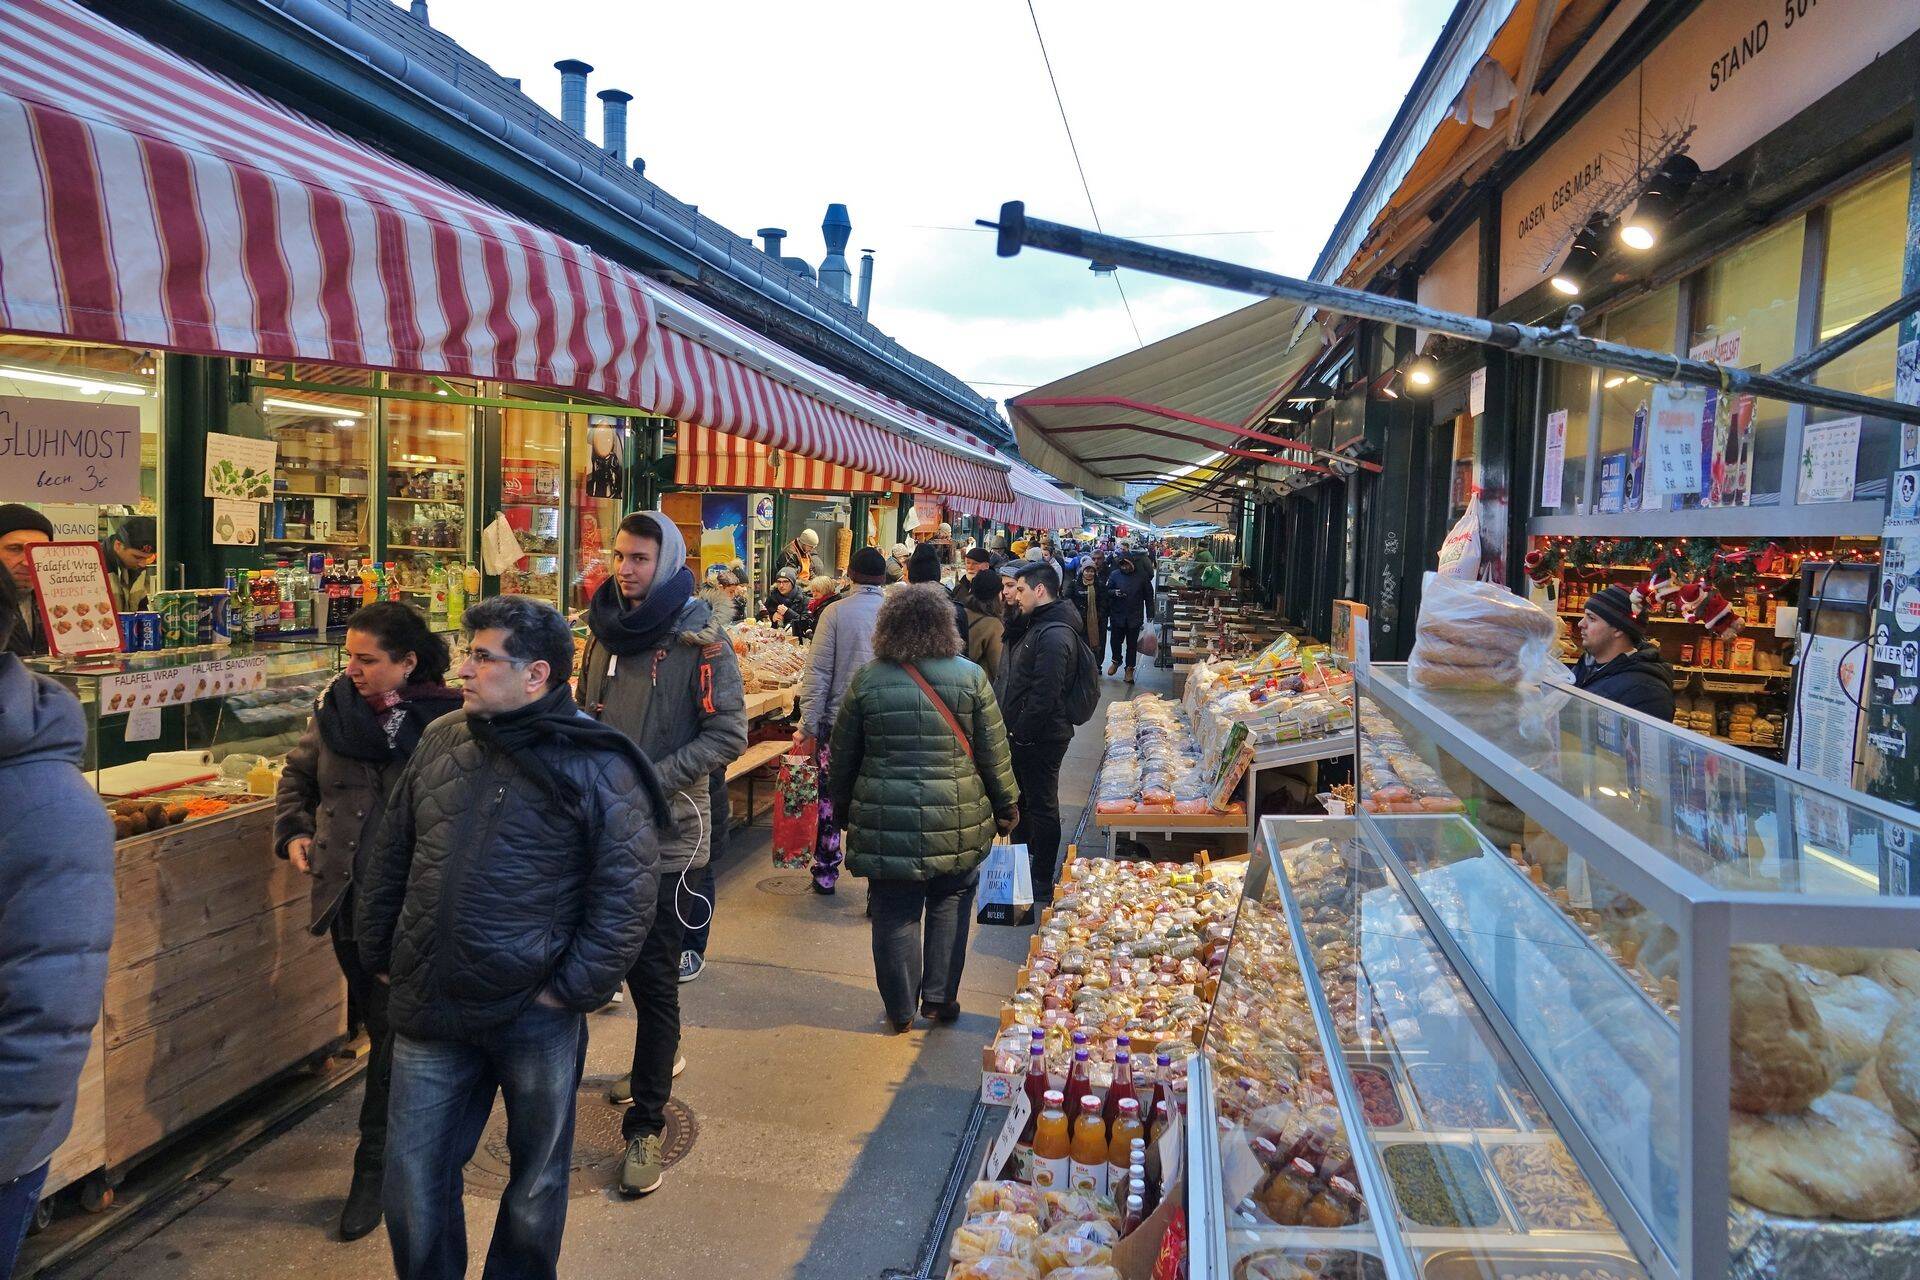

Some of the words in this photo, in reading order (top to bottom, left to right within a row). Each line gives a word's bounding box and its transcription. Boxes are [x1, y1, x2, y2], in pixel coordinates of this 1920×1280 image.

[1710, 19, 1768, 92] STAND
[1784, 0, 1817, 29] 50
[1518, 202, 1546, 239] OASEN
[53, 523, 96, 536] NGANG
[35, 559, 71, 574] Falafel
[48, 571, 96, 585] Sandwich
[192, 660, 224, 675] FALAFEL
[225, 654, 265, 671] SANDWICH
[115, 674, 152, 686] FALAFEL
[154, 668, 179, 681] WRAP
